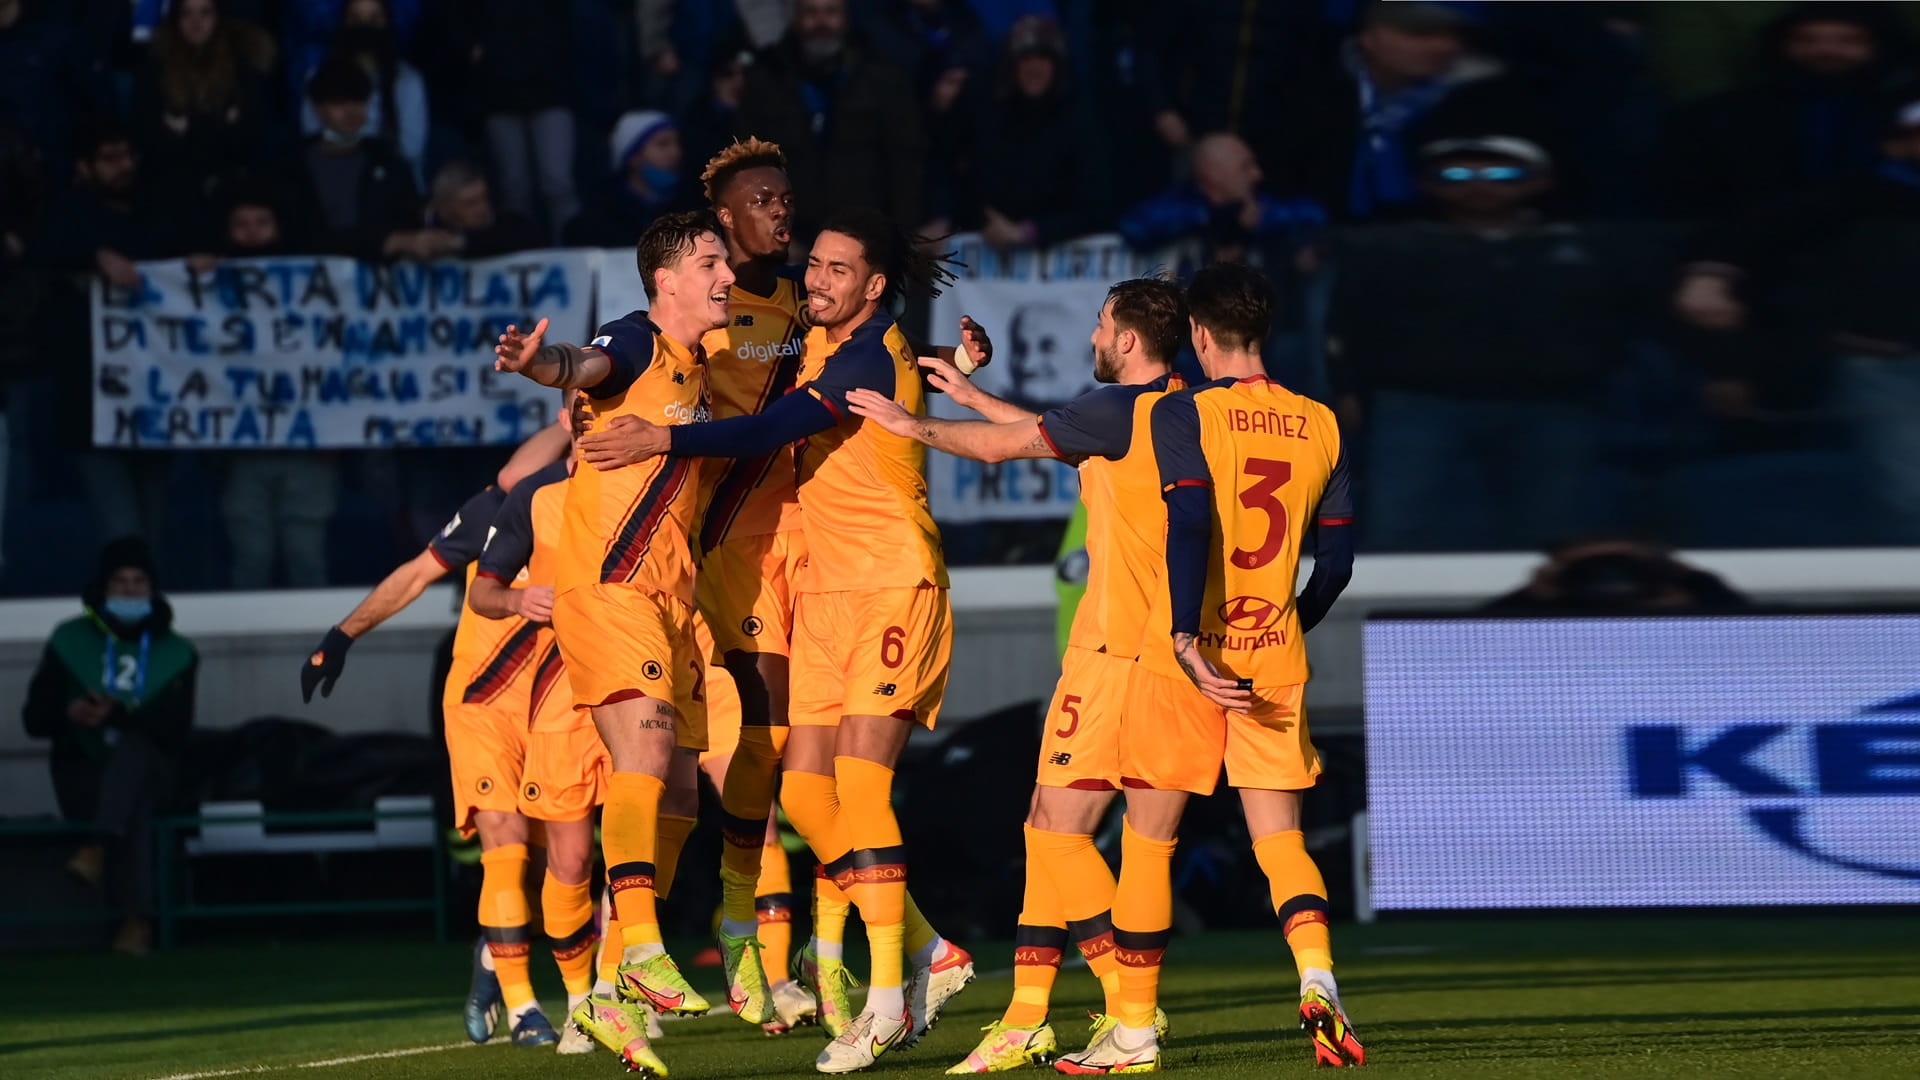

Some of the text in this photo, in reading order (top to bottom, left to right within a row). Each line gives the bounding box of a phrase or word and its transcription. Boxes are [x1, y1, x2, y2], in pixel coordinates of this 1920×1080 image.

[103, 318, 146, 351] DI
[157, 318, 208, 354] TE
[1228, 406, 1309, 440] IBAÑEZ
[1230, 457, 1291, 570] 3
[881, 625, 906, 669] 6
[1197, 629, 1286, 652] HYUNDAI
[1055, 694, 1081, 738] 5
